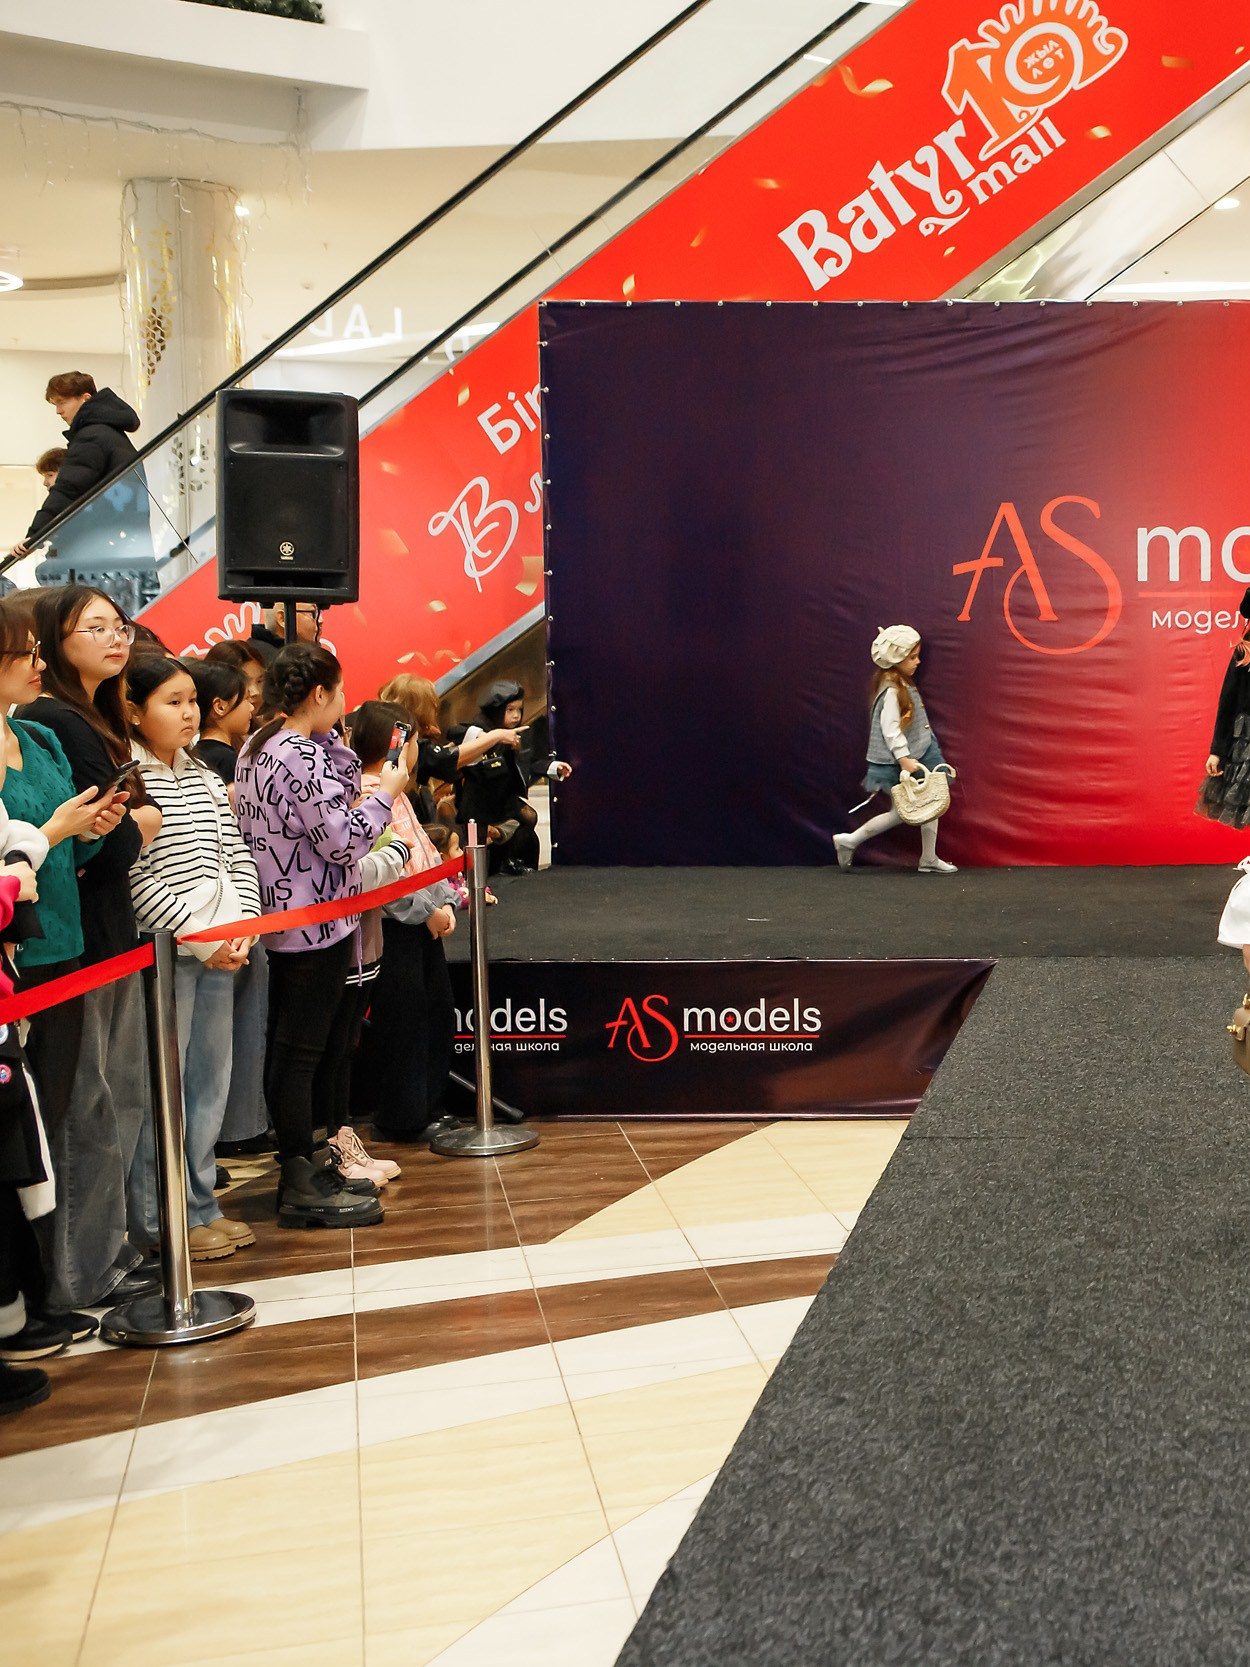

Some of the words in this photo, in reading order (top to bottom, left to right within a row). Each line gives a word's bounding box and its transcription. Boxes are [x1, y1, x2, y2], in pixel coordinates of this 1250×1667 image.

[966, 117, 1067, 204] mall
[777, 119, 976, 292] Batyr
[952, 495, 1123, 655] AS
[515, 1042, 560, 1051] школа
[605, 994, 678, 1062] AS
[683, 998, 822, 1032] models
[690, 1042, 765, 1053] модельная
[769, 1042, 813, 1051] школа
